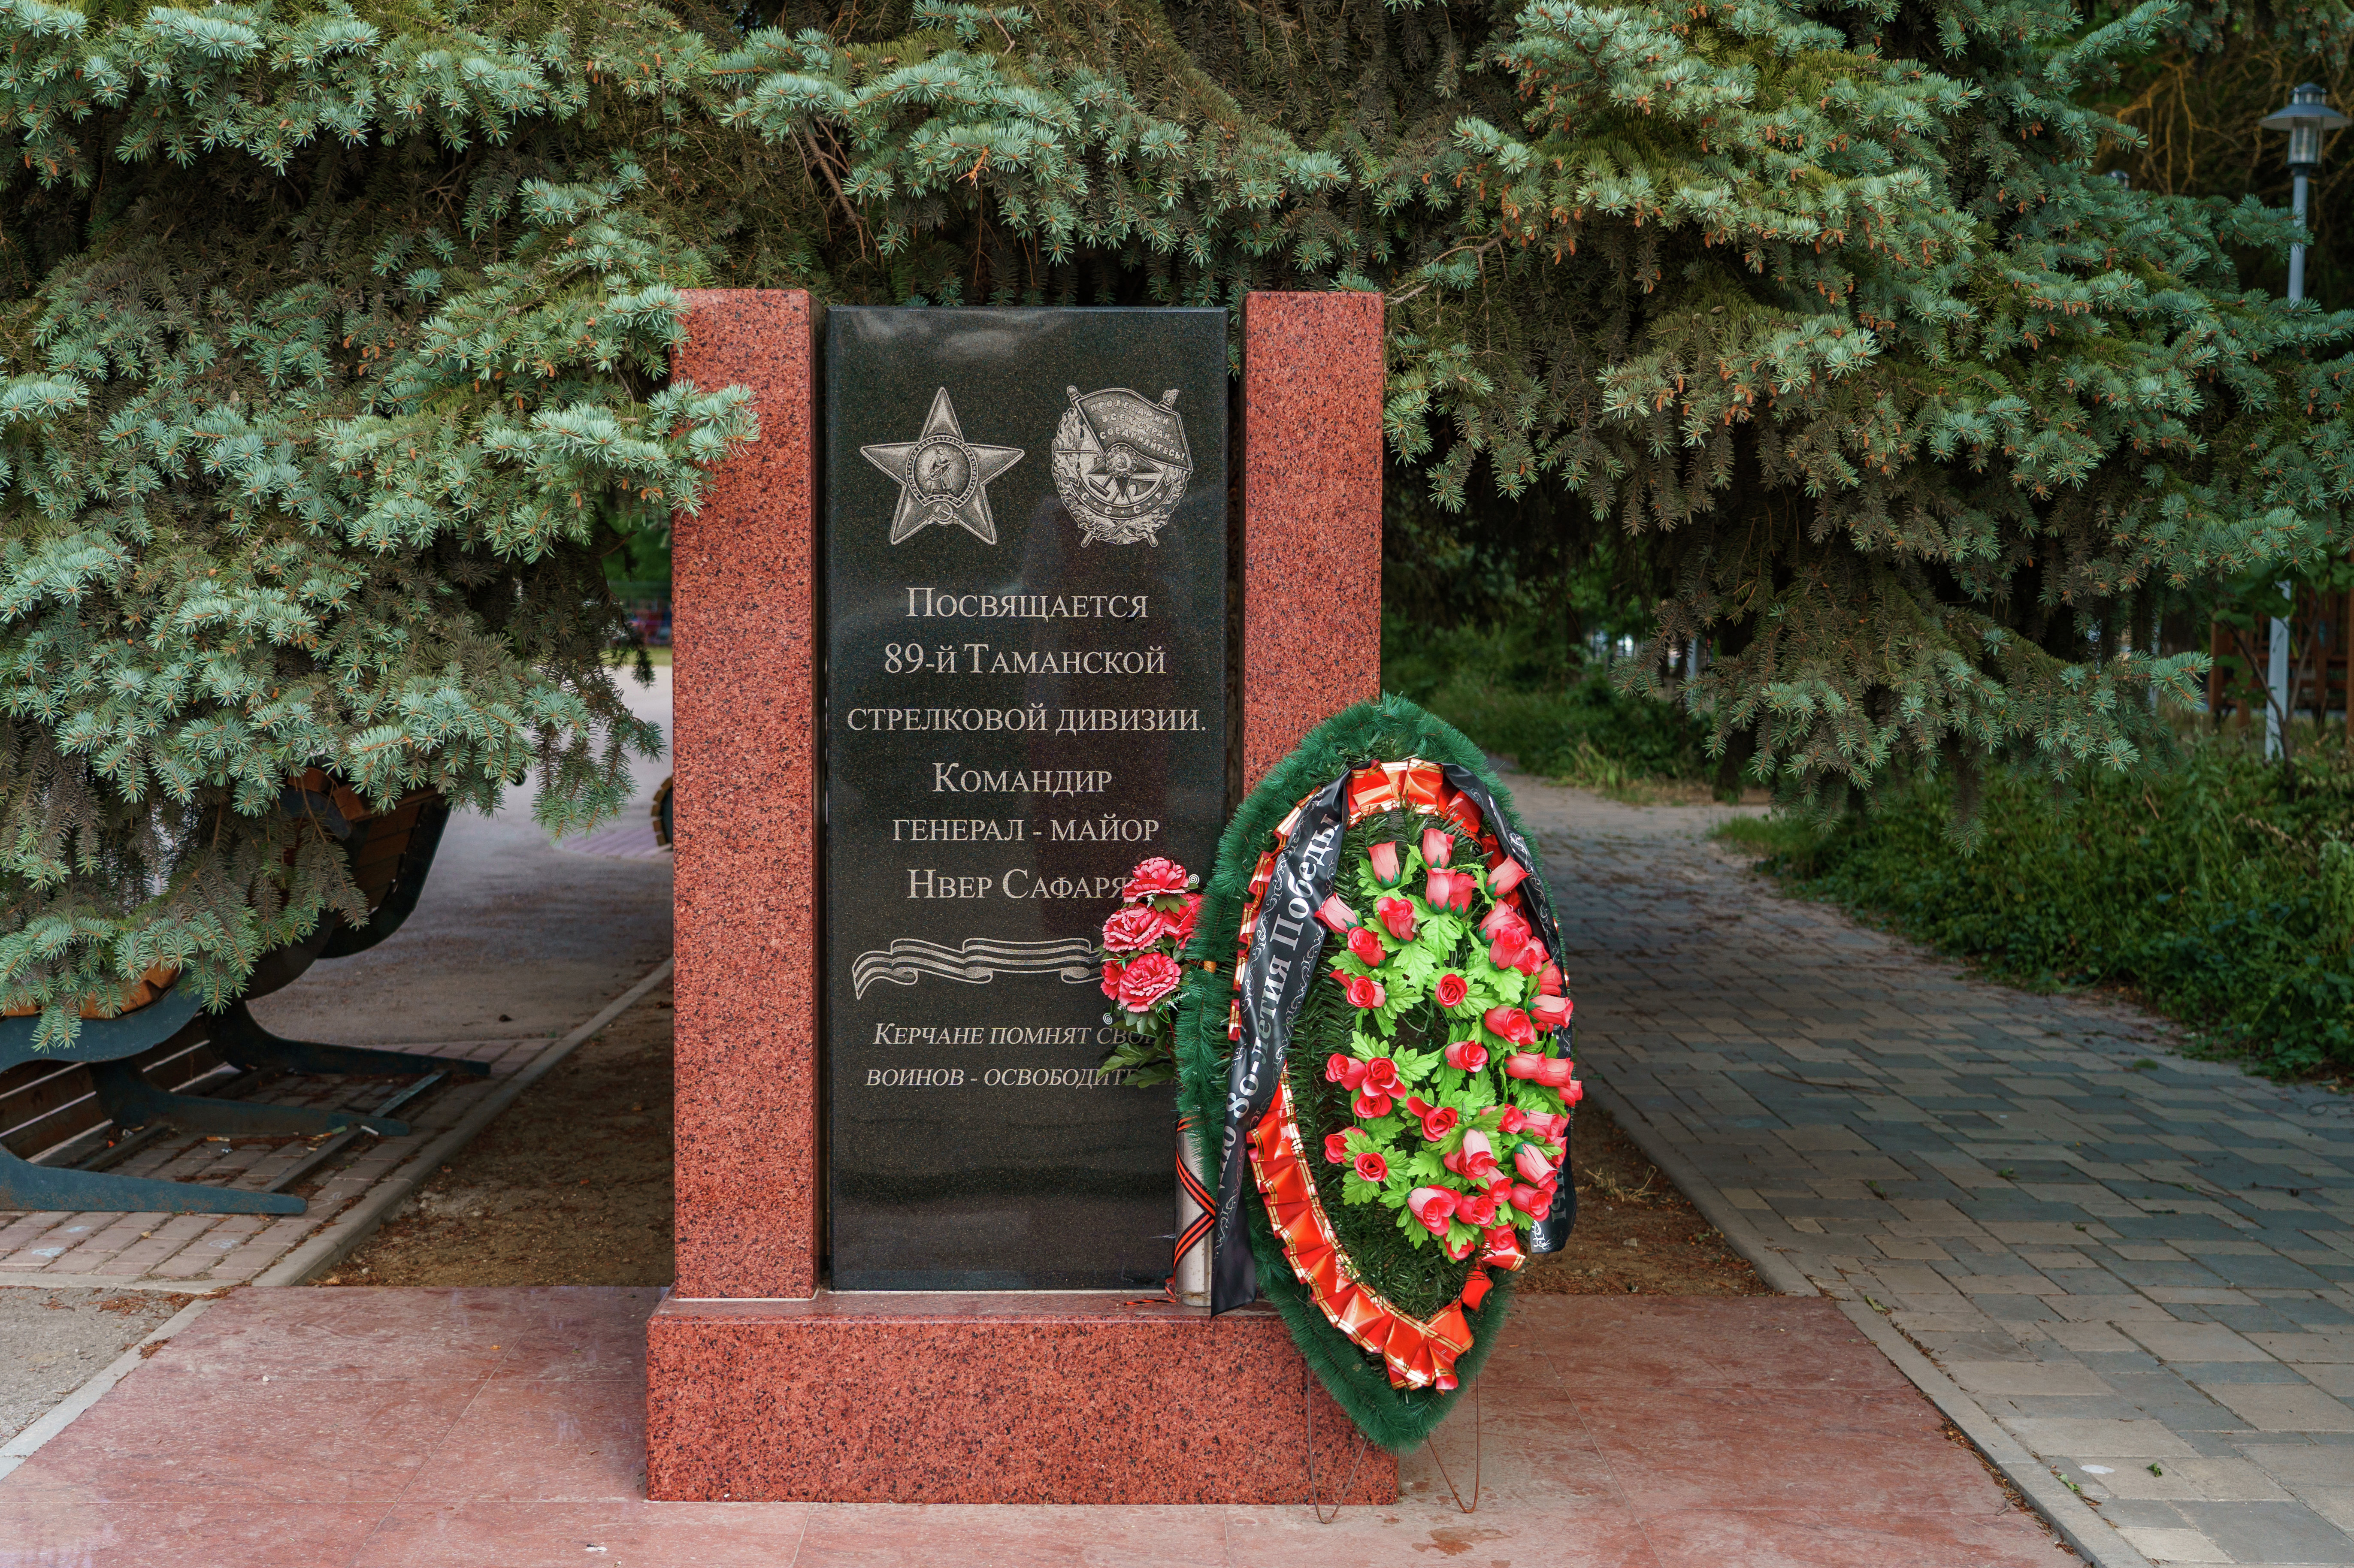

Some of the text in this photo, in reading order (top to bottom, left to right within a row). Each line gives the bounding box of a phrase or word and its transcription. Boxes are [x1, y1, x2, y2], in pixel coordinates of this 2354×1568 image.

[1089, 399, 1170, 426] ПРОЛЕТАРИИ
[1101, 412, 1174, 444] ВСЕХ СТРАН,
[917, 438, 935, 449] ВСЕХ
[1099, 426, 1186, 461] СОЕДИНЯЙТЕСЬ!
[924, 495, 959, 504] СССР
[1002, 868, 1137, 899] САФАРЯ
[1226, 813, 1342, 1119] 80-летия Победы
